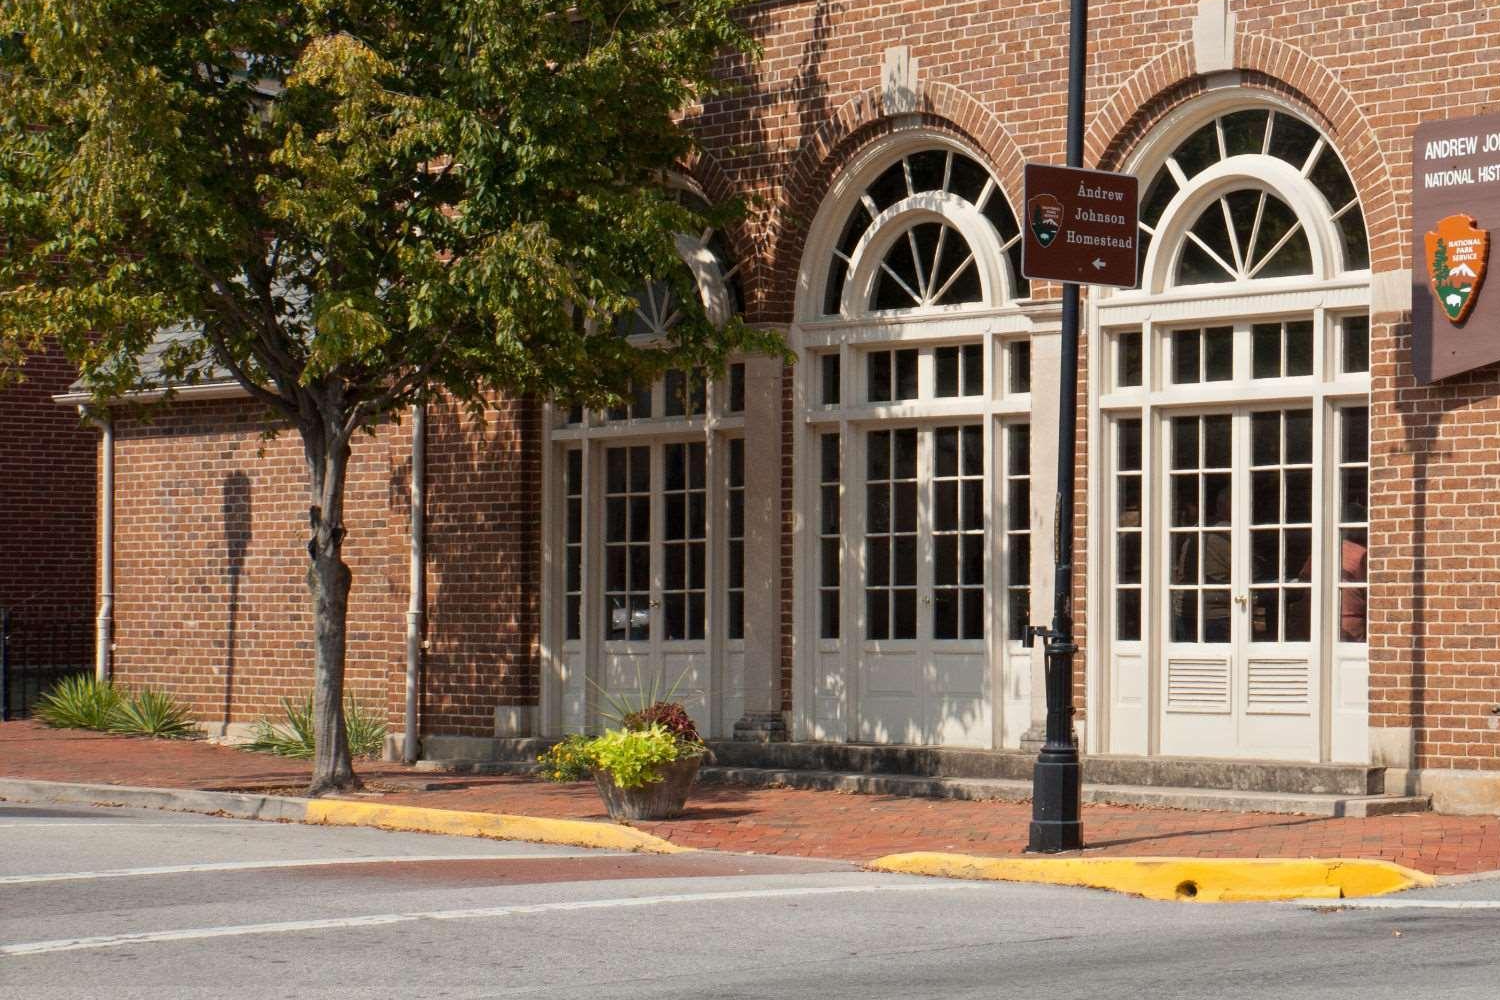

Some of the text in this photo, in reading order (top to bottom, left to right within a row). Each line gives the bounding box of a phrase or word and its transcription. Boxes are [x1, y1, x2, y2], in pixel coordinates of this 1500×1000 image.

[1424, 137, 1477, 160] ANDREW
[1424, 169, 1474, 189] NATIONAL
[1077, 184, 1124, 201] Andrew
[1075, 208, 1125, 224] Johnson
[1067, 231, 1132, 248] Homestead
[1448, 239, 1481, 248] NATIONAL
[1452, 253, 1477, 262] SERVICE
